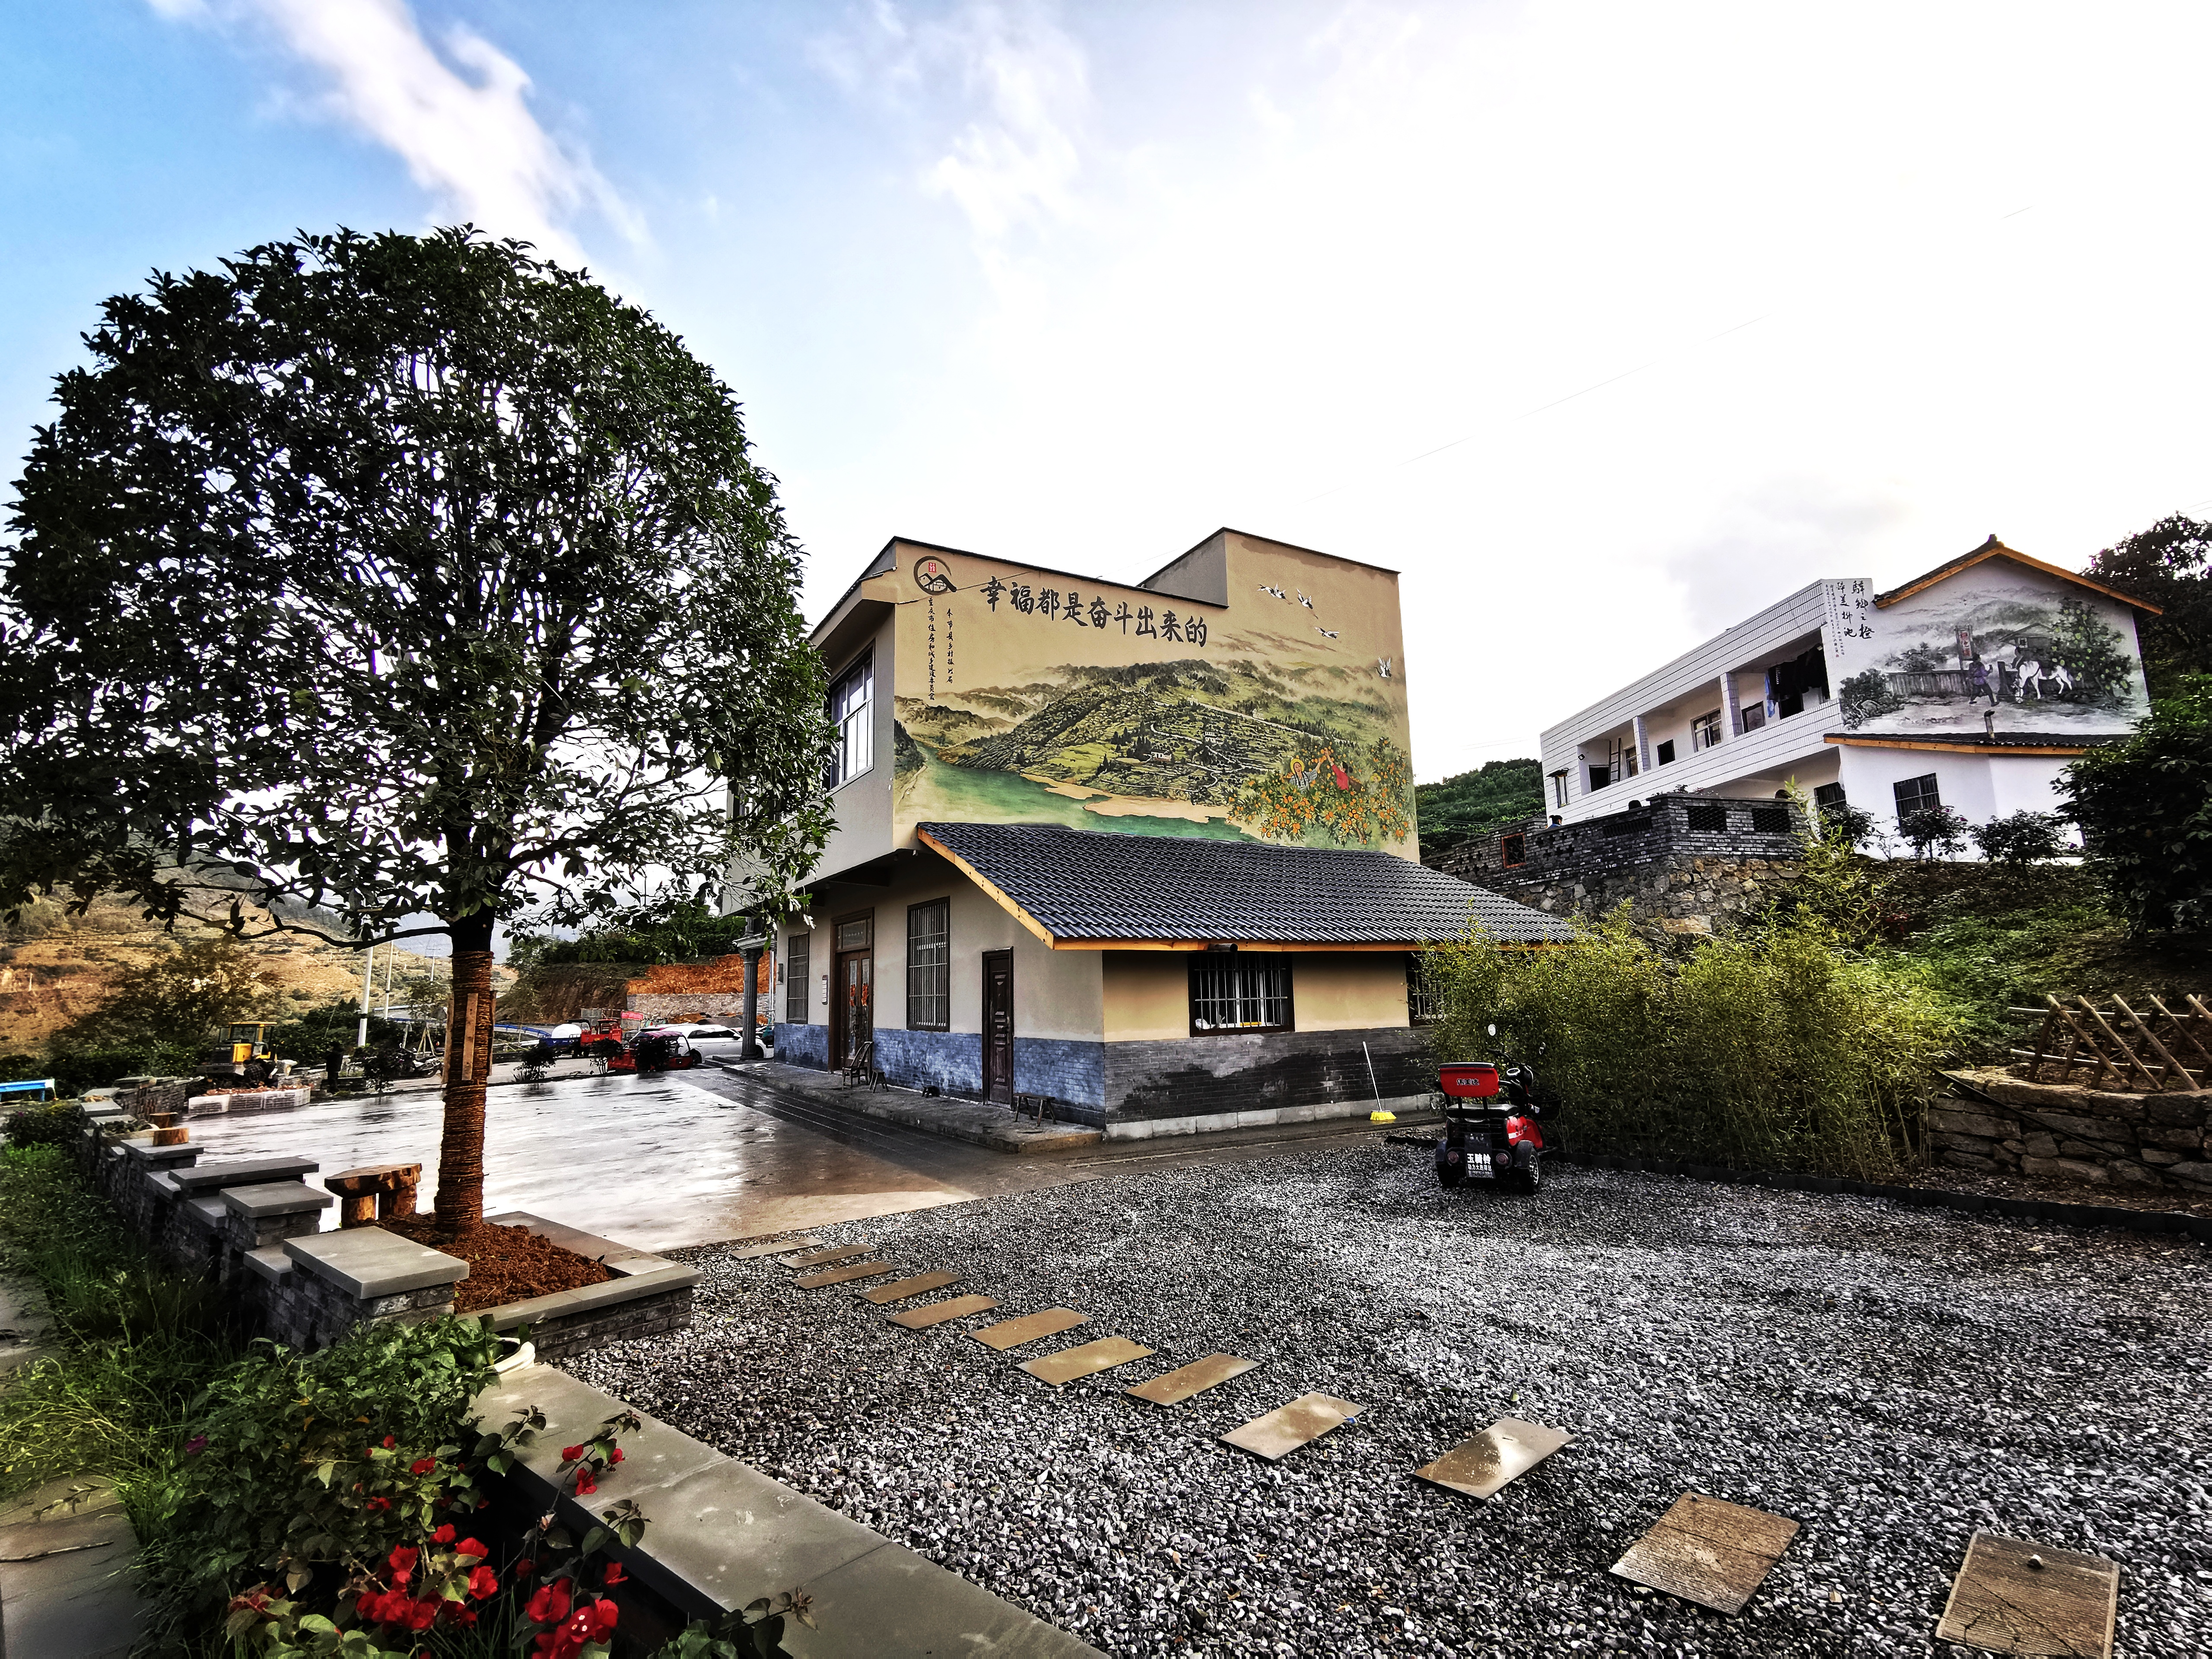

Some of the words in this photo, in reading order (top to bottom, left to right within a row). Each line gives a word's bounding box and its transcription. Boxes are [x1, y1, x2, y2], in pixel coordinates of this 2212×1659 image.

[979, 575, 1208, 648] 幸福都是奋斗出来的
